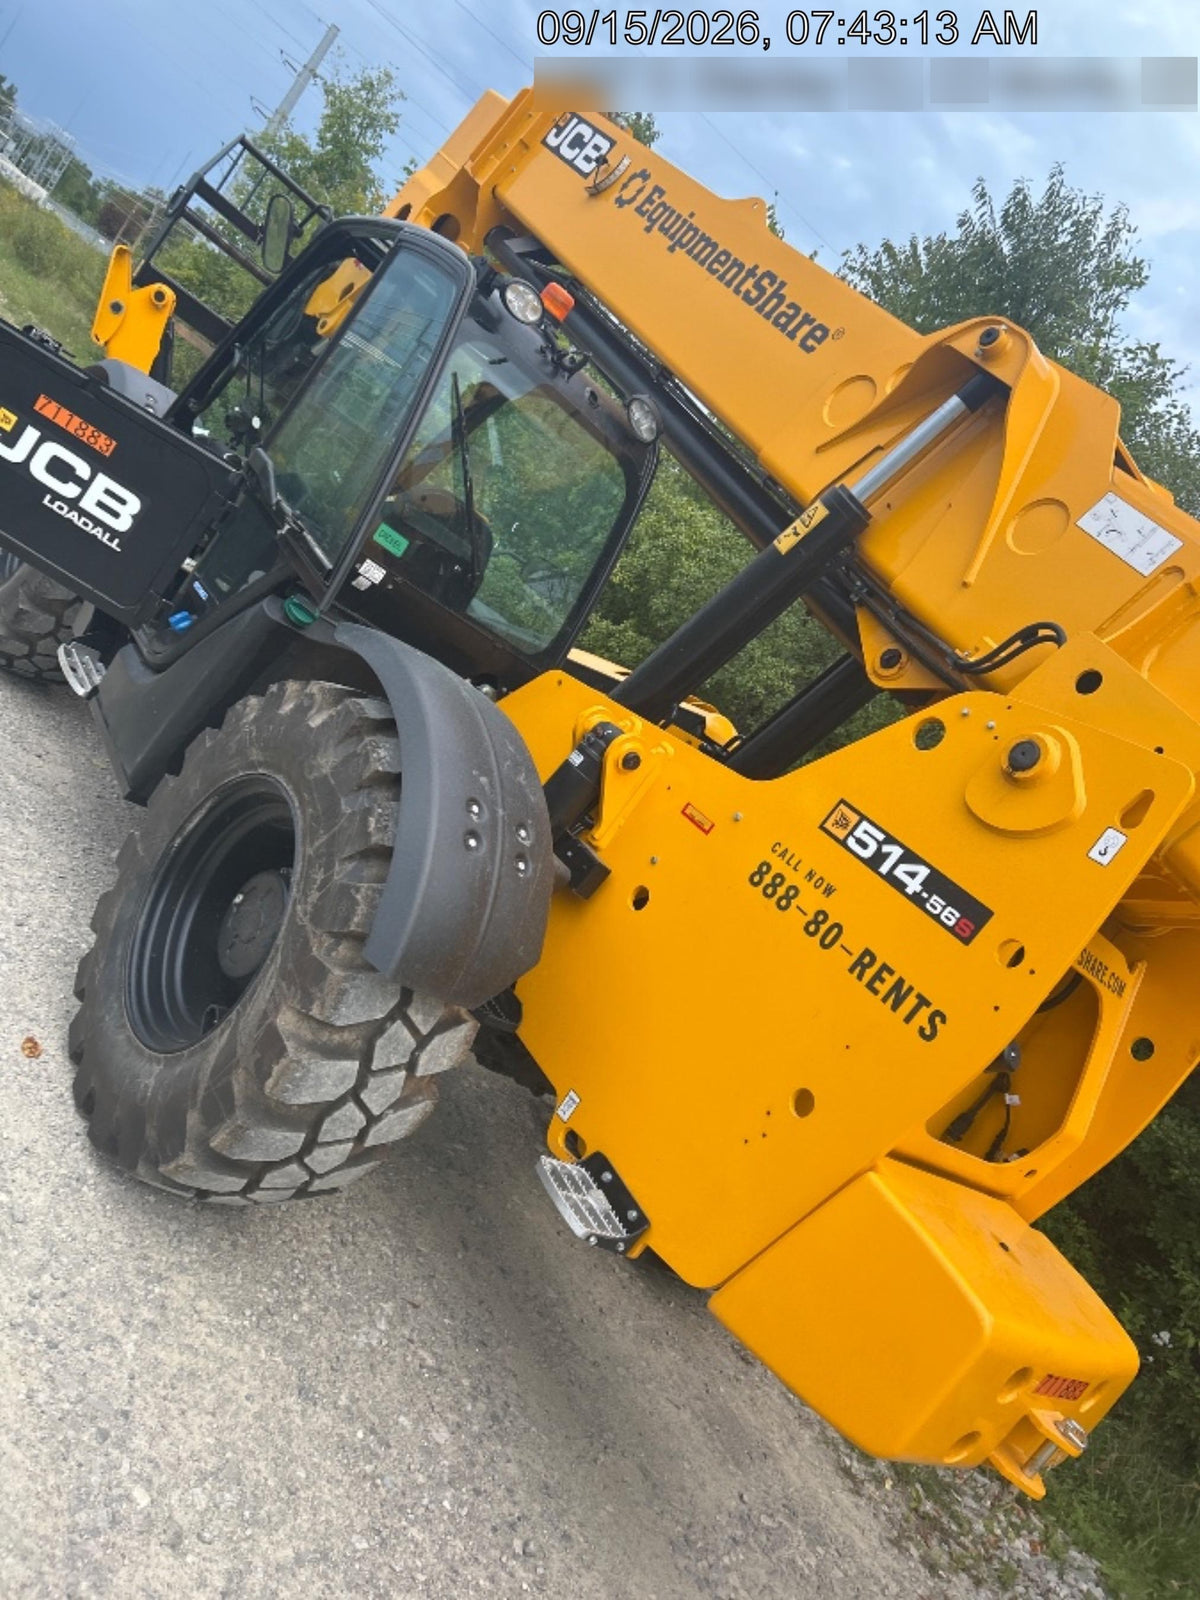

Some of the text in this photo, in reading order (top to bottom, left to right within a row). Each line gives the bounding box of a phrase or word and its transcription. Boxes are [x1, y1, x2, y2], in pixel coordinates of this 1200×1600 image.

[545, 117, 612, 174] JCB
[36, 394, 115, 456] 711883
[0, 424, 142, 533] JCB
[42, 494, 122, 552] LOADALL
[771, 842, 837, 898] CALL NOW
[748, 860, 947, 1042] 888-80-RENTS
